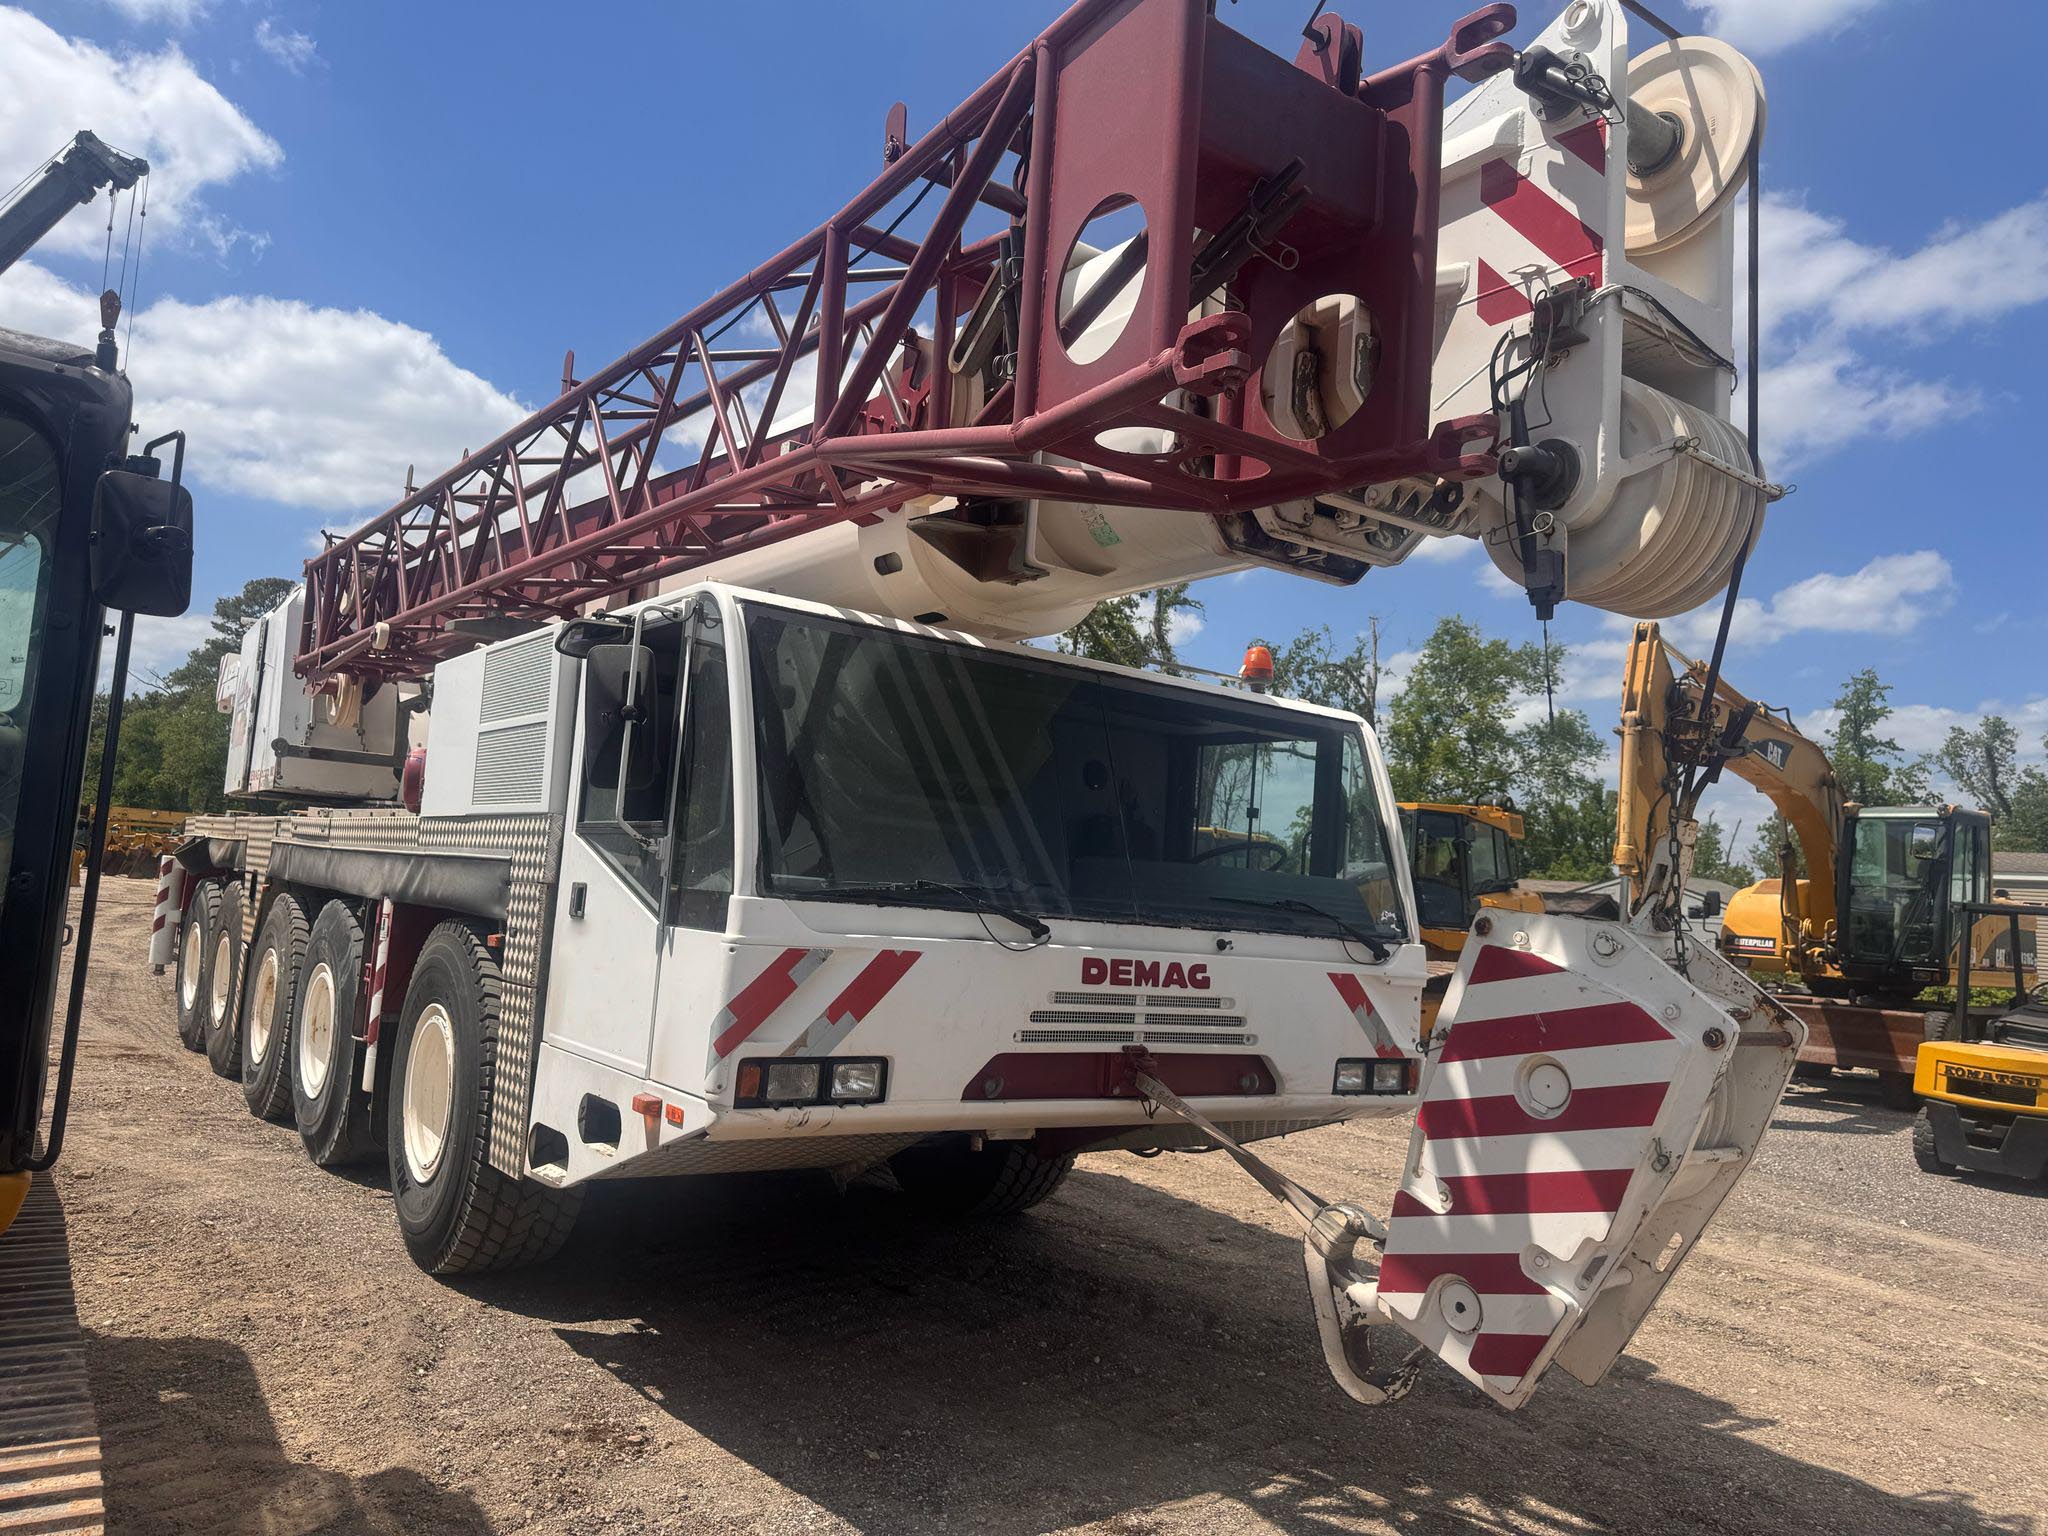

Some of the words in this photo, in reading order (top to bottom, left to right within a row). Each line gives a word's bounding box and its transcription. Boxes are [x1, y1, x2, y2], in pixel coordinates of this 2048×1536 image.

[1767, 741, 1782, 767] CAT
[1735, 938, 1774, 948] CATERPILLAR
[1081, 957, 1211, 989] DEMAG
[1945, 1065, 2041, 1088] KOMATSU
